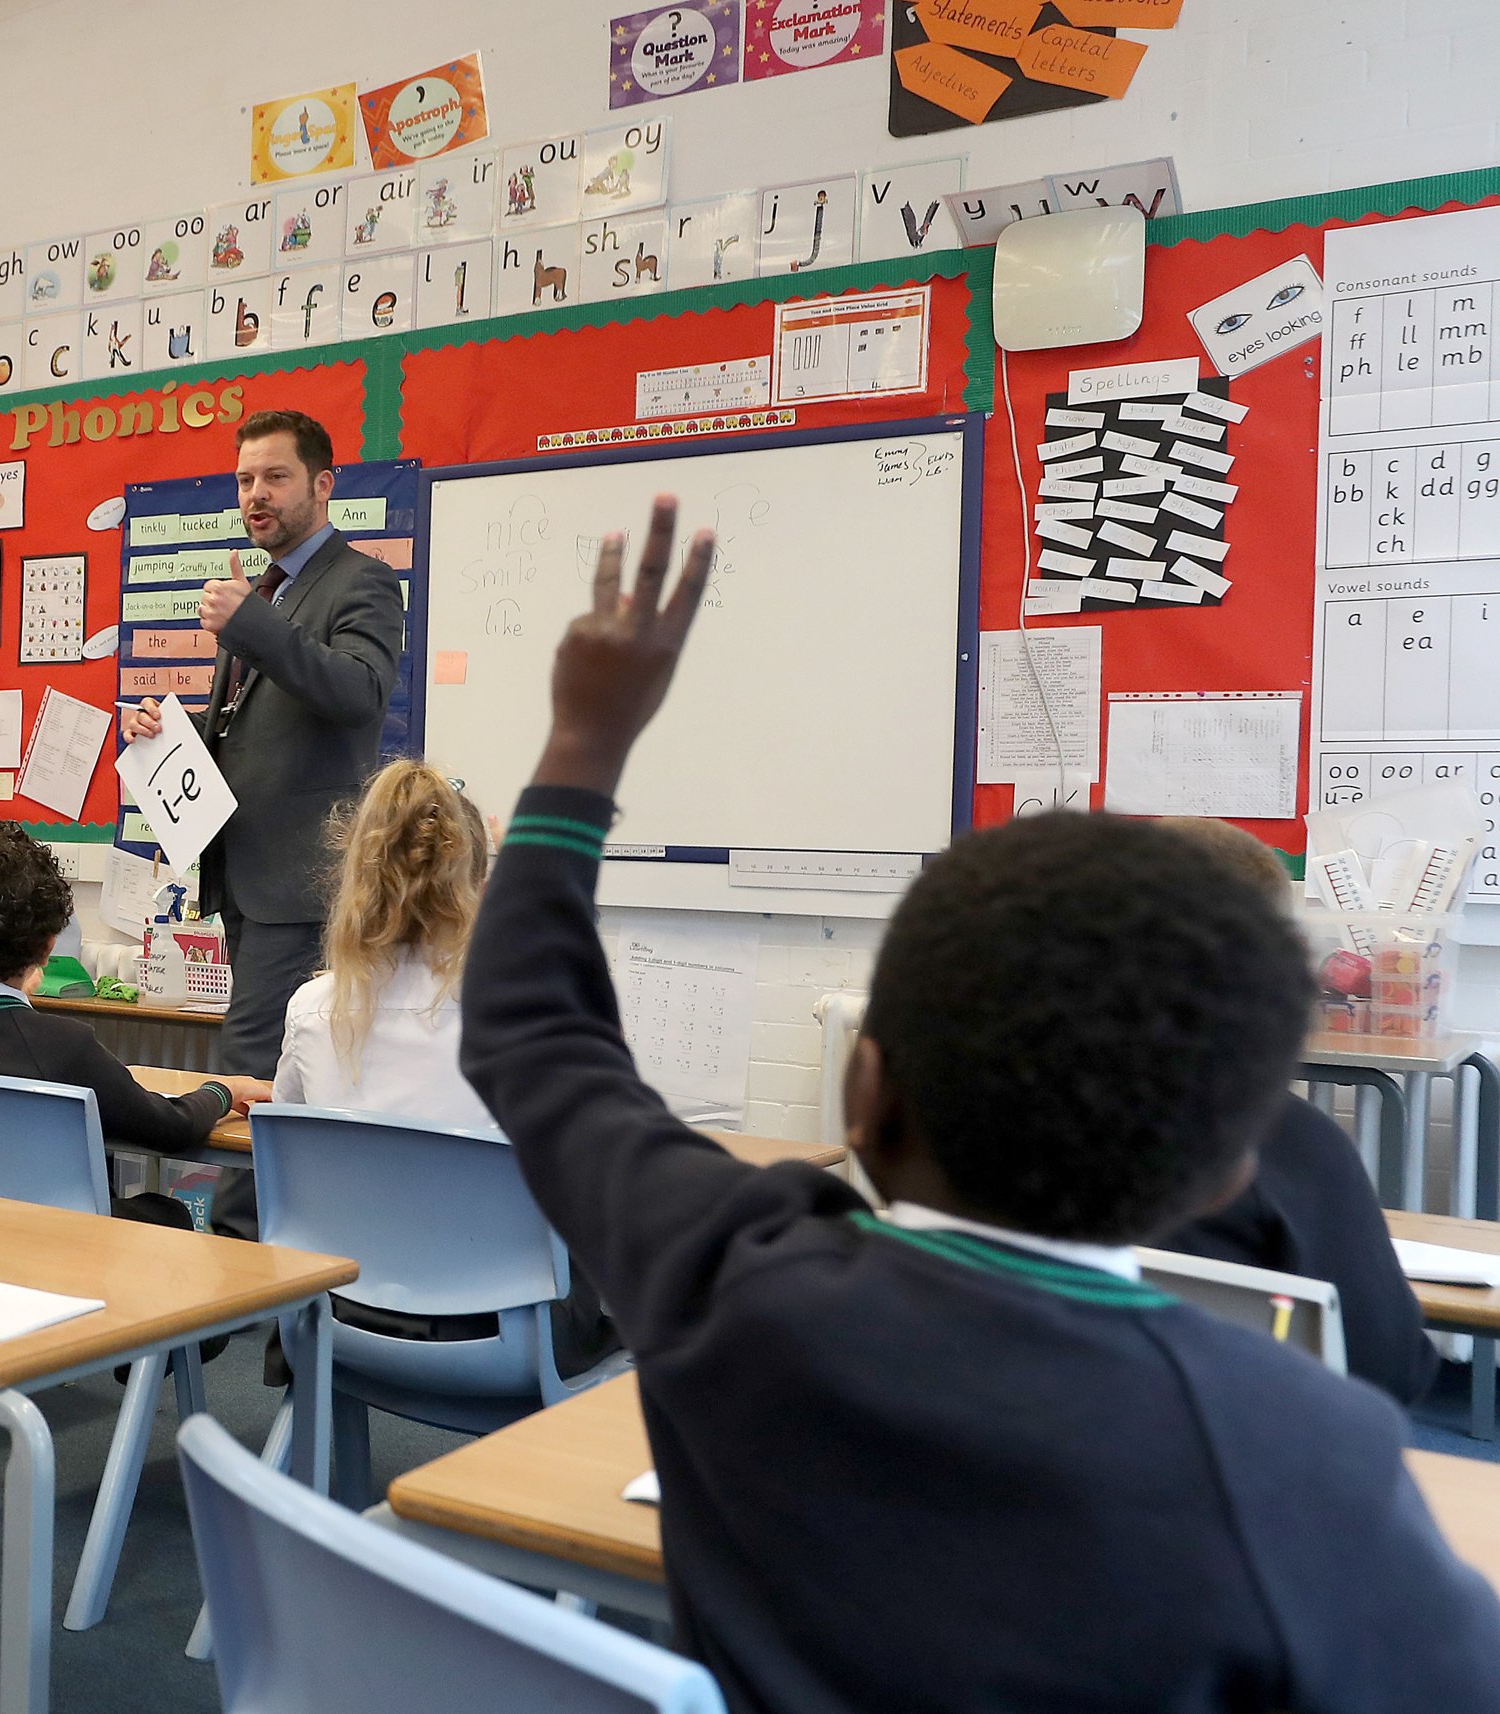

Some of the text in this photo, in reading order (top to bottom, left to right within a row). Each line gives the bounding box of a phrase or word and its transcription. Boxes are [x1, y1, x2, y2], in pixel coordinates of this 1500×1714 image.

[771, 3, 861, 31] Exclamation
[643, 33, 708, 56] Question
[780, 43, 800, 55] Today
[818, 34, 850, 48] amazing!
[793, 25, 836, 42] Mark
[1041, 27, 1115, 60] Capital
[642, 70, 657, 78] What
[665, 67, 678, 76] your
[680, 61, 704, 72] favourite
[655, 52, 694, 68] Mark
[1031, 56, 1096, 82] letters
[650, 79, 661, 87] part
[682, 71, 695, 80] day?
[910, 56, 978, 101] Adjectives
[389, 98, 461, 135] Apostroph
[540, 124, 661, 164] ou oy
[316, 158, 492, 207] or air ir
[679, 181, 891, 238] r j v
[963, 180, 1099, 220] y w
[48, 241, 79, 261] ow
[114, 230, 140, 249] oo
[175, 217, 203, 237] oo
[246, 201, 271, 221] ar
[348, 222, 619, 292] e l h sh
[1336, 265, 1477, 293] Consonant sounds
[29, 330, 38, 346] c
[88, 313, 97, 336] k
[149, 308, 160, 325] u
[212, 289, 224, 314] b
[278, 277, 289, 305] f
[1228, 309, 1322, 363] eyes looking
[1350, 323, 1487, 350] ff ll mm
[1341, 345, 1482, 382] ph le mb
[795, 380, 881, 396] 3 4
[1080, 373, 1170, 395] Spellings
[9, 380, 243, 450] Phonics
[1334, 477, 1498, 503] bb dd gg
[342, 508, 366, 520] Ann
[1379, 507, 1404, 526] ck
[141, 518, 218, 535] tinkly tucked
[1377, 535, 1405, 553] ch
[134, 560, 174, 575] jumping
[210, 562, 224, 570] Ted
[1328, 578, 1429, 594] Vowel sounds
[149, 635, 198, 647] the I
[1403, 637, 1432, 649] ea
[134, 672, 190, 685] said be
[1330, 767, 1358, 778] oo
